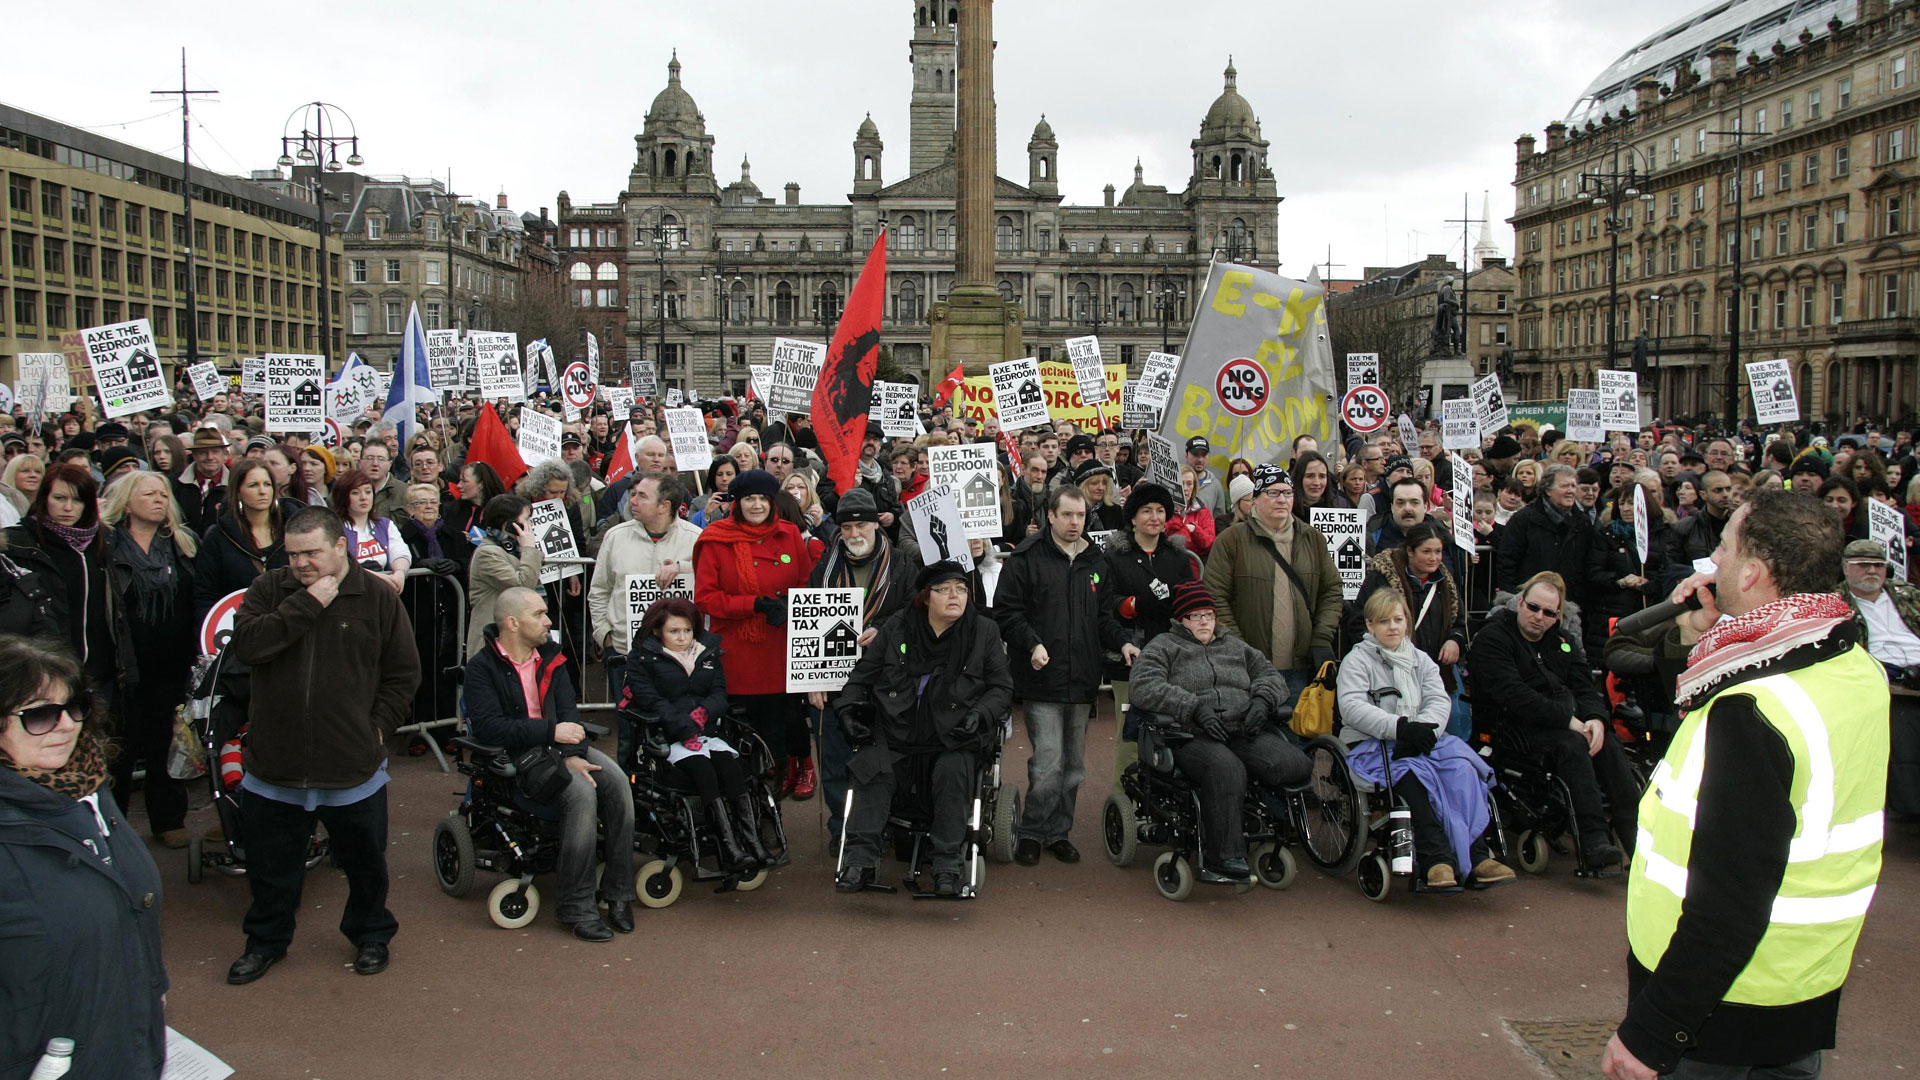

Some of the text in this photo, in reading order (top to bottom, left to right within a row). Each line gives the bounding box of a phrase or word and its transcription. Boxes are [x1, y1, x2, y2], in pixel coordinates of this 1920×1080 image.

[88, 326, 140, 343] AXE THE
[478, 336, 493, 344] AXE
[90, 335, 150, 354] BEDROOM
[430, 337, 452, 347] AXE THE
[430, 347, 457, 358] BEDROOM
[478, 344, 515, 352] BEDROOM
[1071, 344, 1093, 358] AXE THE
[25, 354, 62, 365] DAVID
[94, 352, 119, 364] TAX
[776, 347, 815, 363] AXE THE
[269, 359, 315, 368] AXE THE
[430, 358, 455, 367] TAX NOW
[775, 360, 820, 376] BEDROOM
[1073, 355, 1100, 370] BEDROOM
[1148, 360, 1176, 370] BEDROOM
[100, 367, 123, 378] CAN'T
[269, 368, 321, 377] BEDROOM
[993, 362, 1030, 375] AXE THE
[571, 371, 587, 382] NO
[994, 369, 1036, 383] BEDROOM
[1076, 369, 1088, 381] TAX
[1088, 368, 1101, 379] NOW
[1229, 370, 1255, 383] NO
[1752, 370, 1788, 380] BEDROOM
[103, 375, 126, 388] PAY
[269, 378, 290, 386] TAX
[773, 372, 790, 385] TAX
[793, 376, 815, 389] NOW
[1473, 377, 1493, 393] AXE THE
[1601, 381, 1635, 389] BEDROOM
[106, 380, 162, 398] WON'T LEAVE
[568, 384, 593, 396] CUTS
[996, 382, 1013, 391] TAX
[1124, 386, 1135, 394] AXE
[1474, 382, 1498, 399] BEDROOM
[123, 389, 164, 404] EVICTIONS
[784, 389, 806, 397] evictions
[963, 386, 993, 404] NO
[1222, 387, 1264, 399] CUTS
[270, 398, 291, 406] PAY
[782, 397, 800, 405] benefit
[1000, 400, 1017, 408] PAY
[1355, 394, 1377, 404] NO
[1124, 404, 1152, 412] TAX NOW
[1347, 408, 1383, 418] CUTS
[1516, 407, 1544, 415] GREEN
[1769, 408, 1796, 416] EVICTIONS
[1014, 411, 1045, 421] EVICTIONS
[932, 448, 985, 461] AXE THE
[1160, 443, 1172, 459] THE
[933, 460, 993, 473] BEDROOM
[1151, 450, 1179, 472] BEDROOM
[1152, 461, 1178, 482] TAX NOW
[934, 474, 958, 484] TAX
[910, 485, 950, 511] DEFEND
[533, 504, 555, 515] THE
[922, 502, 940, 517] THE
[970, 509, 996, 518] LEAVE
[1871, 504, 1899, 524] AXE THE
[533, 511, 564, 526] ROOM
[1314, 513, 1357, 522] AXE THE
[962, 520, 997, 528] ICTIONS
[1314, 524, 1362, 534] BEDROOM
[1872, 512, 1902, 536] BEDROOM
[1872, 522, 1886, 536] TAX
[630, 579, 685, 590] AXE HE
[630, 591, 693, 602] BEDROOM
[793, 593, 851, 605] AXE THE
[630, 603, 650, 614] TA
[793, 606, 858, 618] BEDROOM
[792, 619, 819, 630] TAX
[793, 646, 818, 657] PAY
[792, 660, 855, 669] WON'T LEAVE
[808, 671, 851, 679] EVICTION
